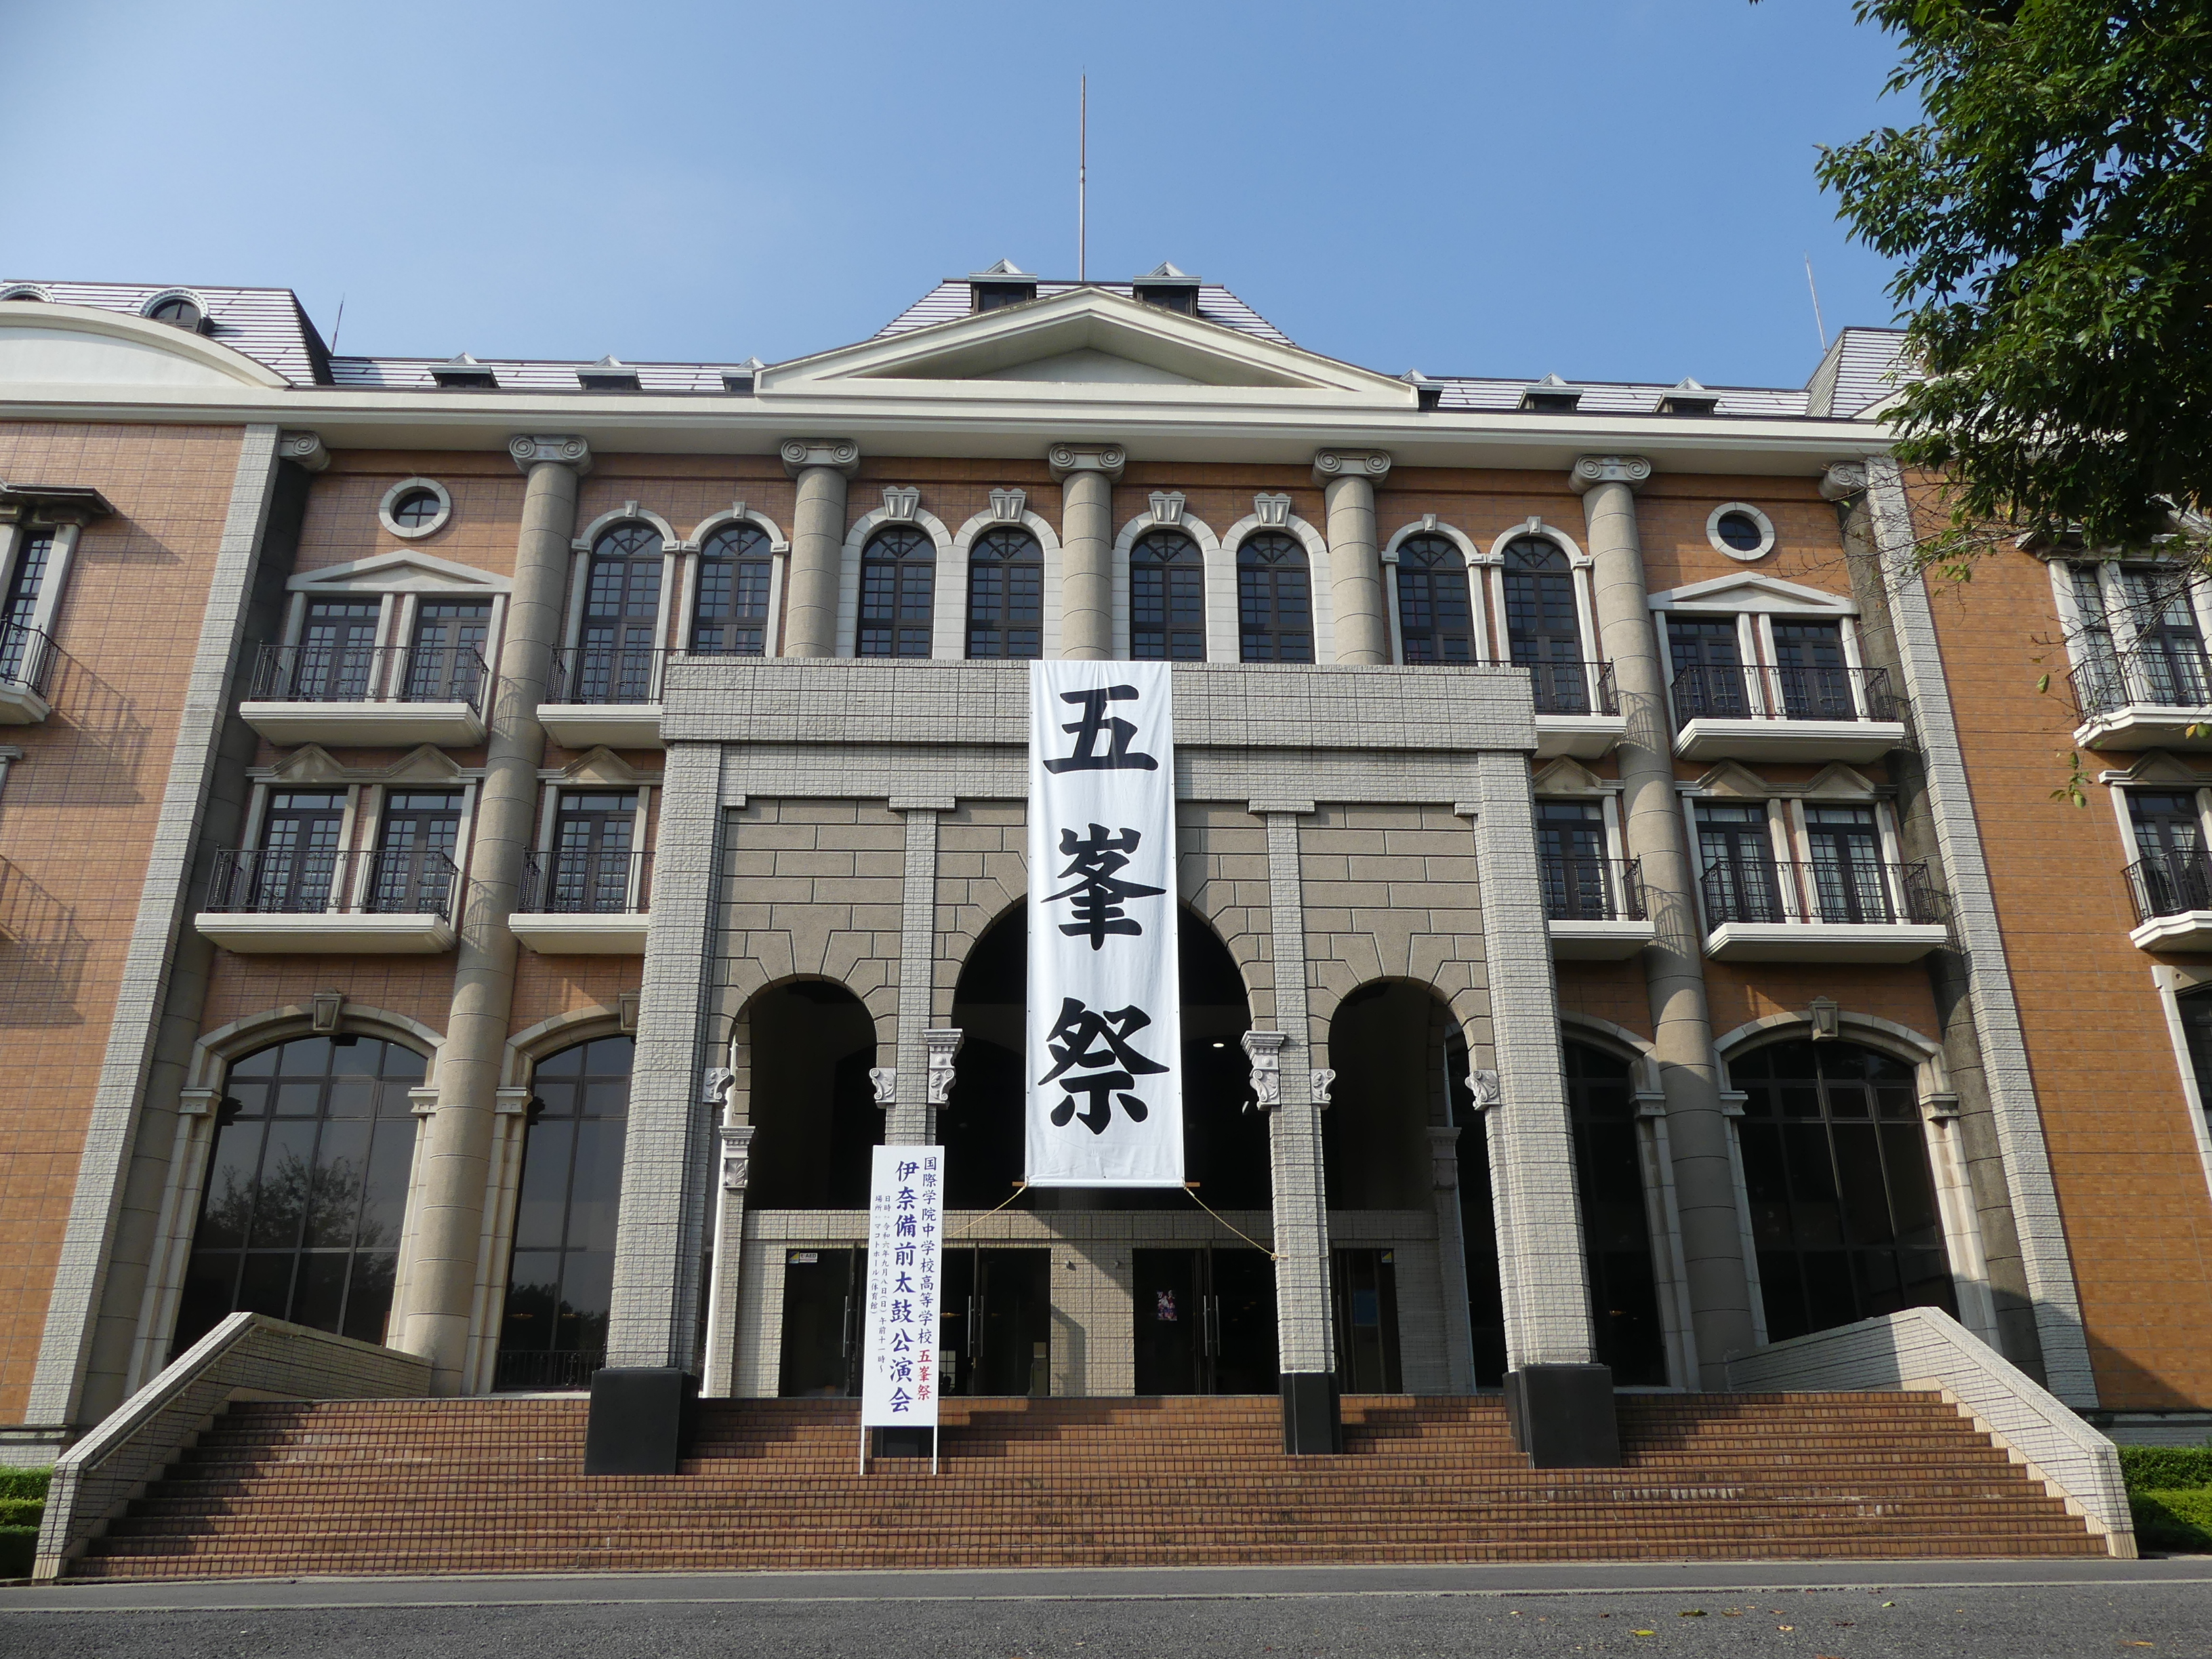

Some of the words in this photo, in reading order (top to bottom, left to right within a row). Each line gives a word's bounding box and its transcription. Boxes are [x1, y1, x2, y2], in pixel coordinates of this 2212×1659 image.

[1038, 684, 1170, 1135] 五峯祭
[888, 1160, 920, 1413] 伊奈備前太鼓公演会
